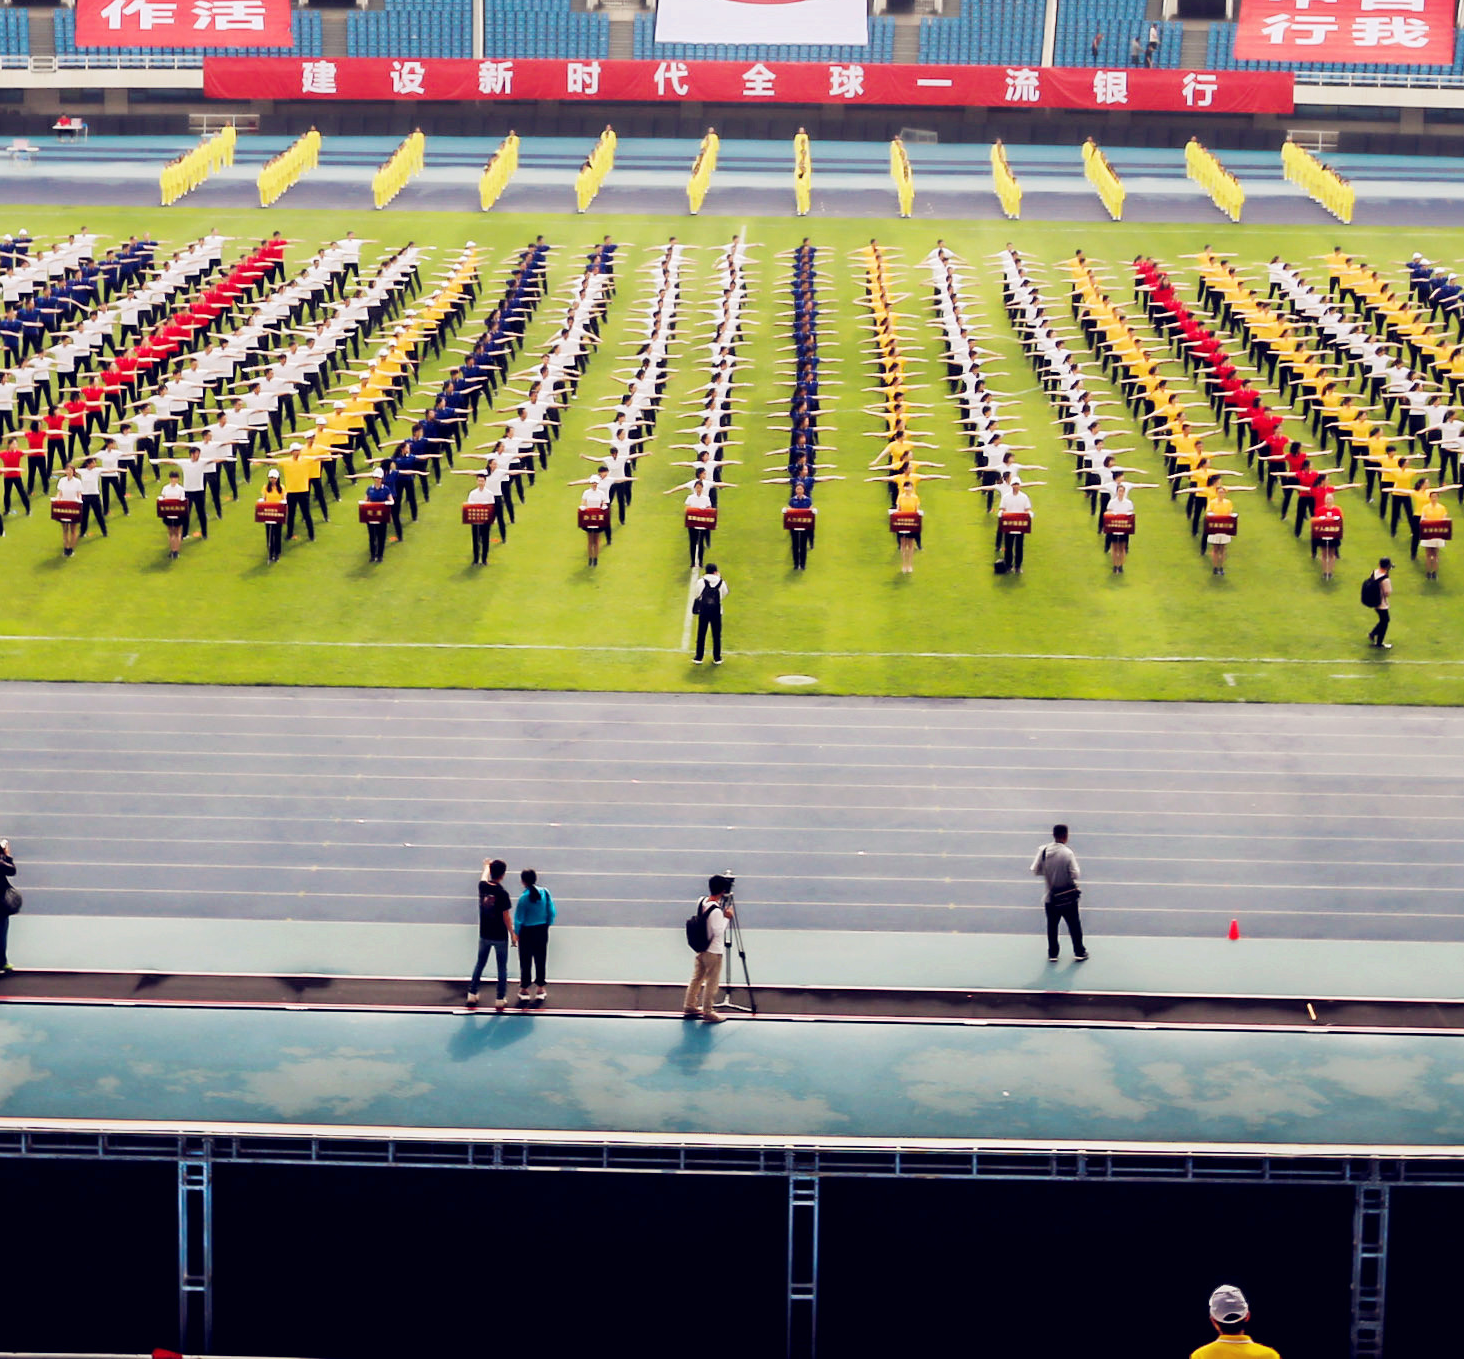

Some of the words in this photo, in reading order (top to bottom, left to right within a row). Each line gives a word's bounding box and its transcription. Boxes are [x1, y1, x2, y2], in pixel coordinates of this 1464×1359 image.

[302, 62, 1217, 106] 建设新时代全球一流银行
